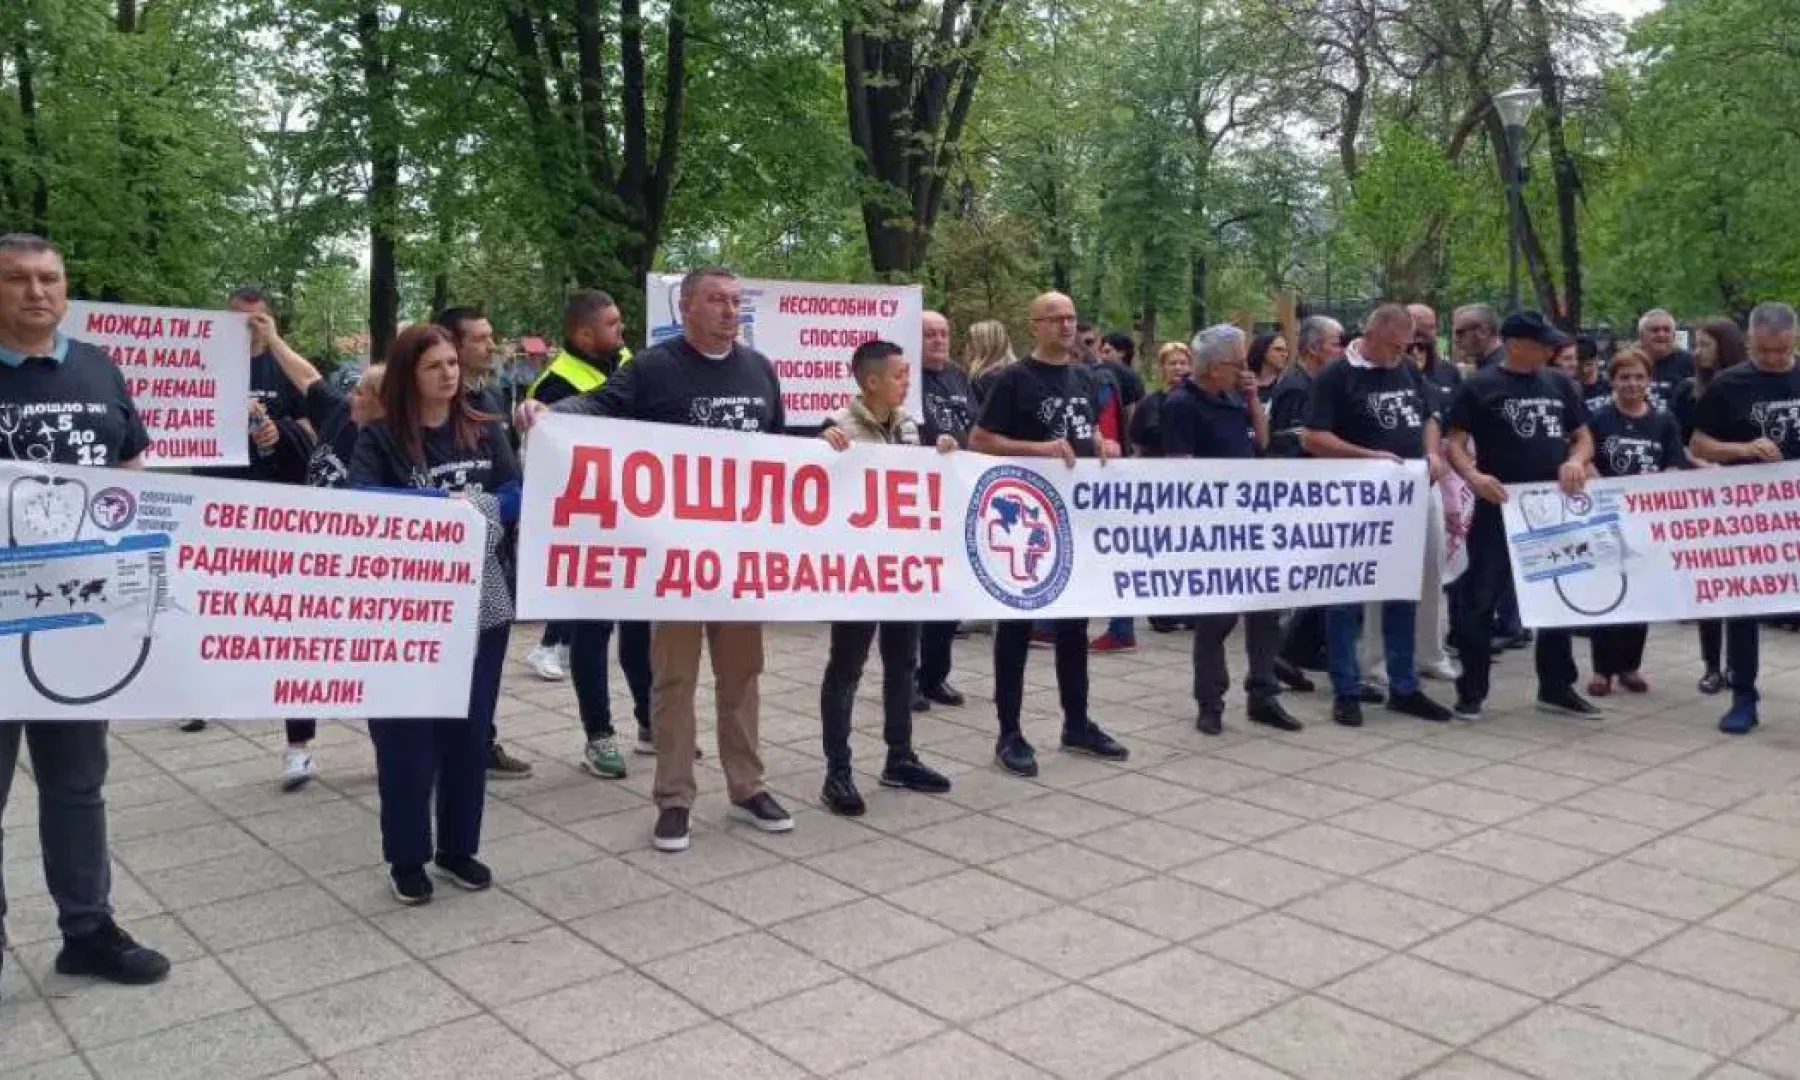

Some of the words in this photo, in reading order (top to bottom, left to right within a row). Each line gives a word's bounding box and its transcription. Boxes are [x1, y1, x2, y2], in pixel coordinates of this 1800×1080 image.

[779, 296, 876, 316] НЕСПОСОБНИ
[880, 299, 898, 317] СУ
[86, 313, 164, 339] МОЖДА
[169, 318, 190, 337] ТИ
[192, 320, 214, 339] ЈЕ
[102, 346, 147, 367] АТА
[152, 348, 204, 370] МАЛА,
[775, 361, 844, 378] ПОСОБНЕ
[152, 378, 215, 398] НЕМАШ
[58, 414, 72, 430] 5
[165, 408, 215, 430] ДАНЕ
[68, 430, 94, 445] ДО
[146, 439, 223, 458] РОШИШ.
[77, 444, 106, 465] 12
[552, 445, 829, 529] ДОШЛО
[847, 468, 941, 530] ЈЕ!
[1072, 482, 1229, 514] СИНДИКАТ
[1236, 481, 1391, 512] ЗДРАВСТВА
[1398, 481, 1414, 505] И
[1625, 487, 1716, 512] УНИШТИ
[203, 502, 248, 528] СВЕ
[252, 506, 403, 539] ПОСКУПЉУЈЕ
[407, 518, 464, 544] САМО
[1651, 522, 1665, 541] И
[1094, 524, 1265, 557] СОЦИЈАЛНЕ
[1272, 521, 1394, 550] ЗАШТИТЕ
[178, 545, 293, 578] РАДНИЦИ
[299, 553, 342, 577] СВЕ
[346, 555, 476, 584] ЈЕФТИНИЈИ.
[1671, 543, 1777, 570] УНИШТИО
[546, 545, 646, 589] ПЕТ
[656, 549, 721, 597] ДО
[733, 551, 943, 598] ДВАНАЕСТ
[1113, 567, 1280, 598] РЕПУБЛИКЕ
[1288, 561, 1378, 590] СРПСКЕ
[1695, 572, 1799, 603] ДРЖАВУ!
[197, 590, 238, 616] ТЕК
[243, 592, 292, 621] КАД
[299, 594, 344, 620] НАС
[348, 598, 454, 623] ИЗГУБИТЕ
[201, 636, 344, 662] СХВАТИЋЕТЕ
[350, 639, 397, 662] ШТА
[403, 640, 440, 663] СТЕ
[273, 680, 363, 703] ИМАЛИ!
